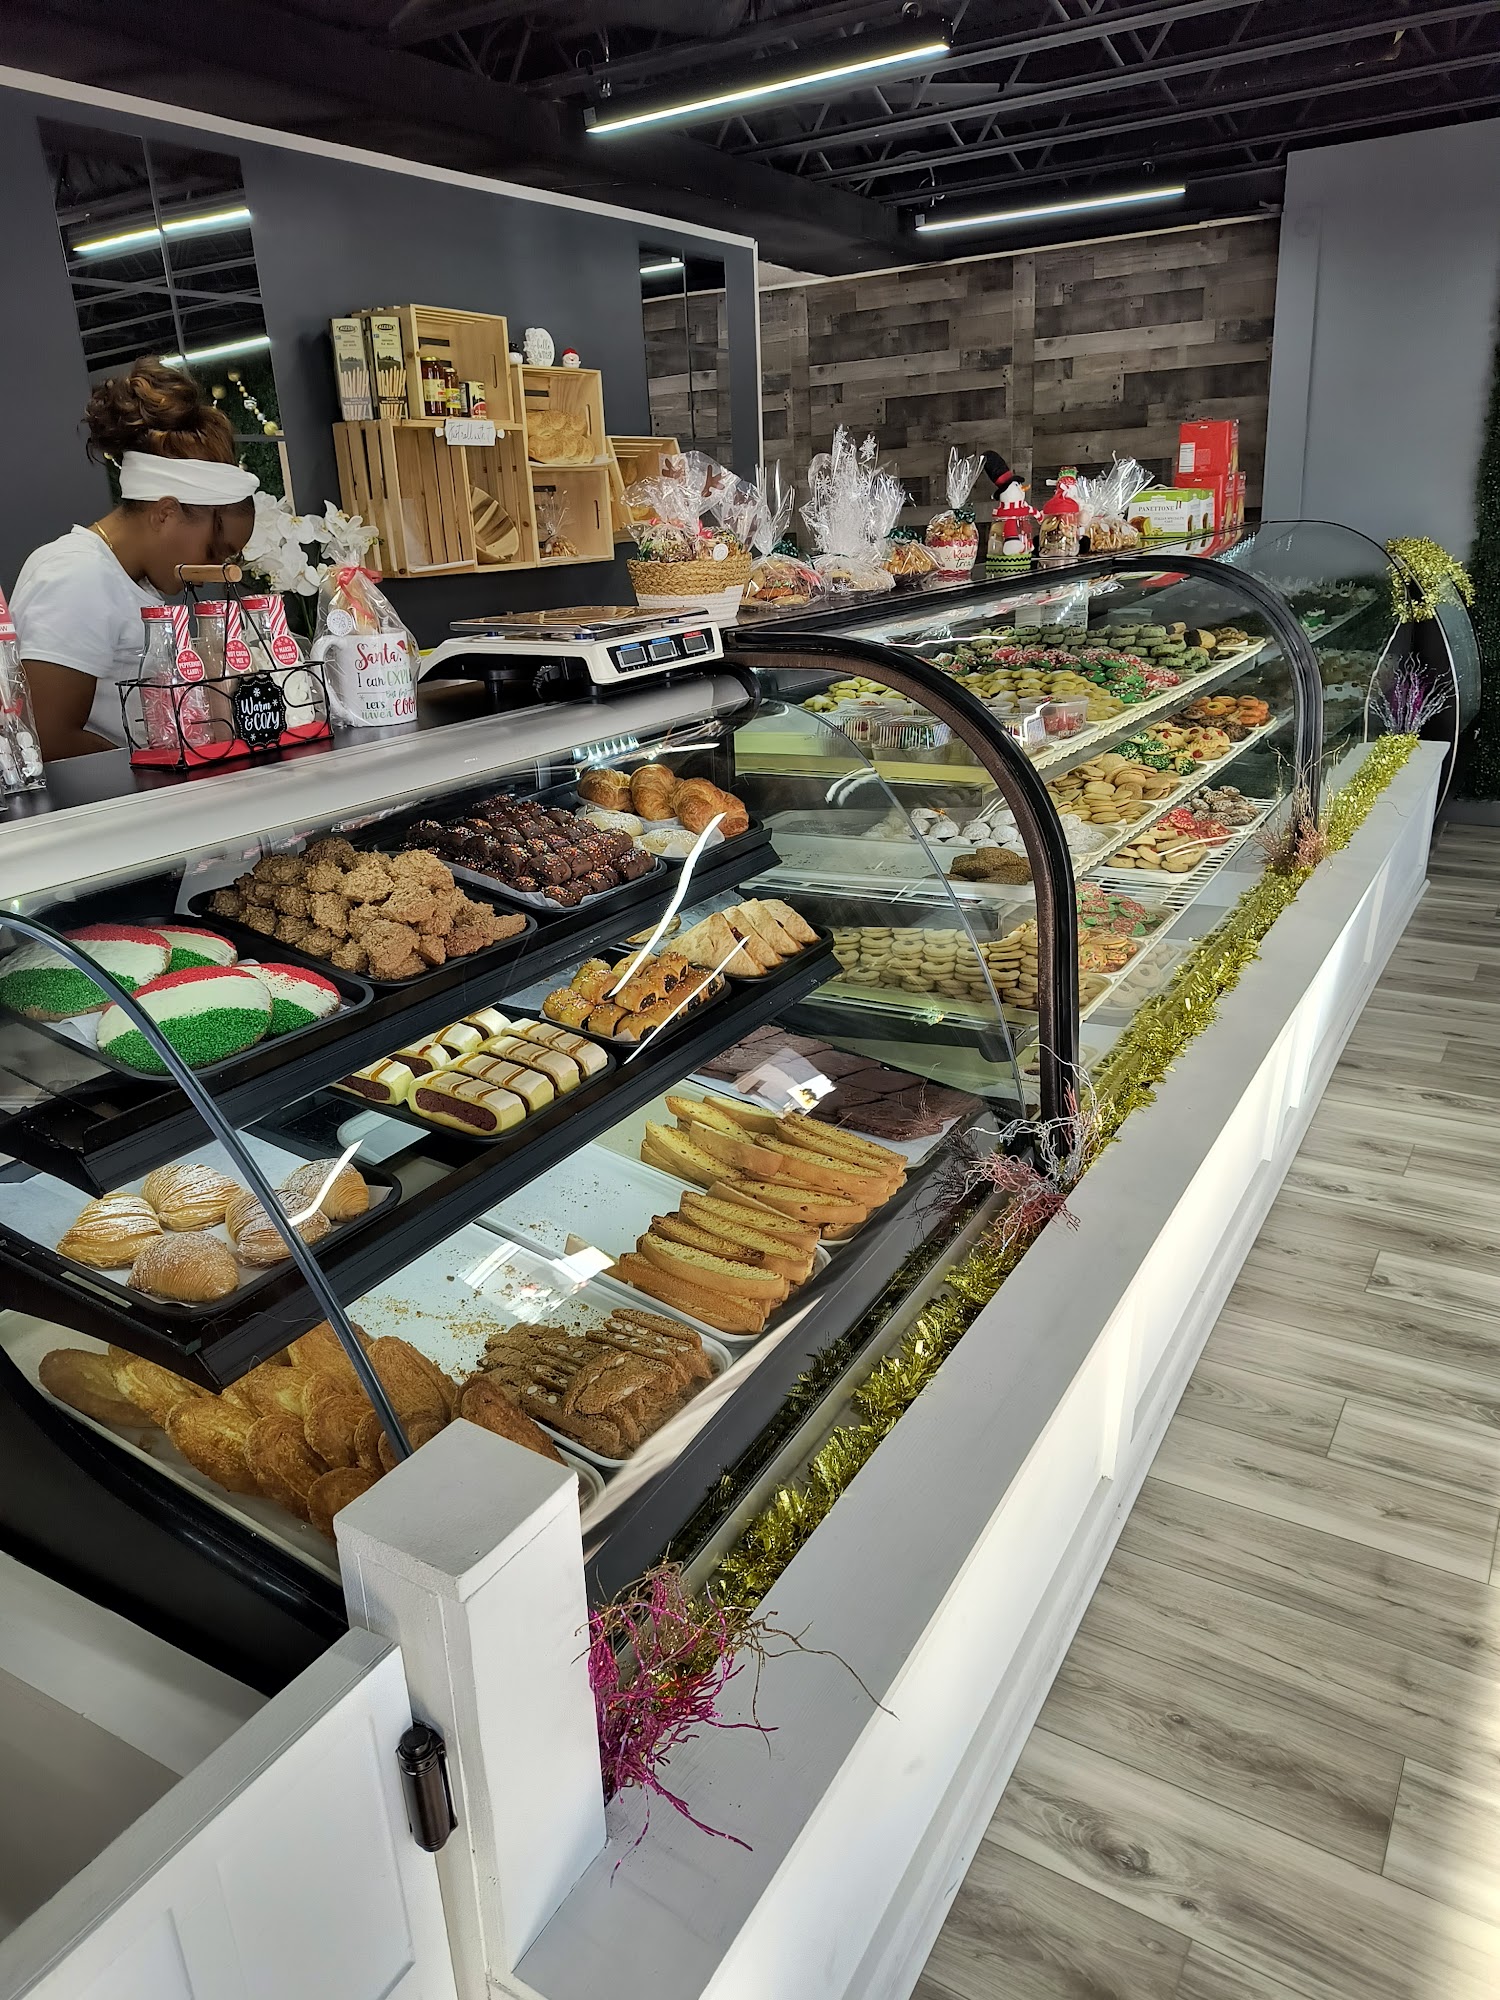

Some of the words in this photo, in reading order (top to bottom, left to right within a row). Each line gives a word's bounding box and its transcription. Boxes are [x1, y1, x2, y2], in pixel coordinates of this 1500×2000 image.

[356, 672, 363, 688] I
[366, 675, 385, 688] can
[241, 696, 272, 715] Warm
